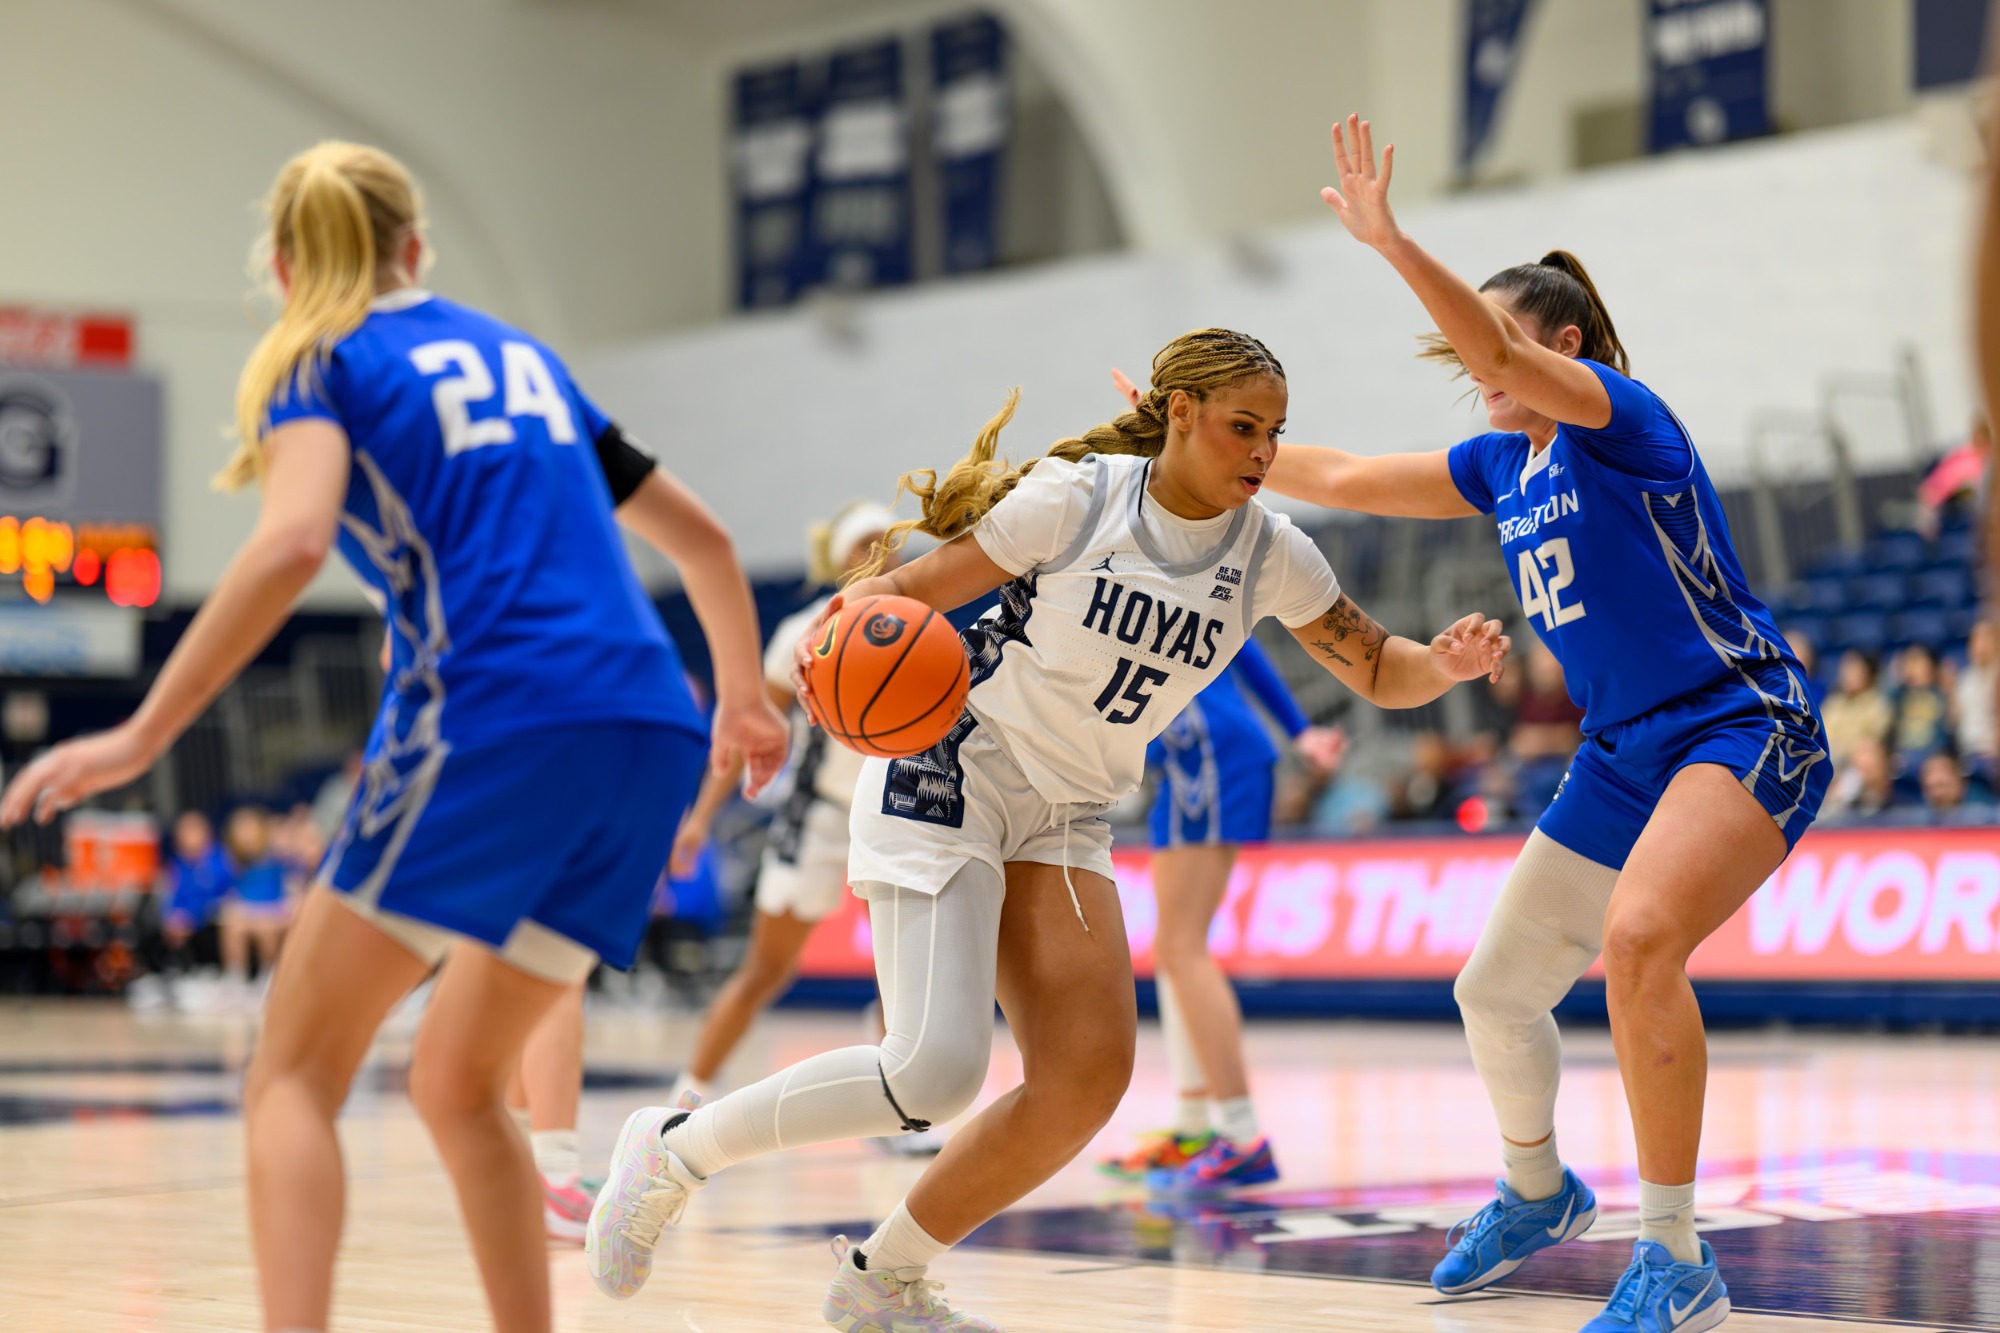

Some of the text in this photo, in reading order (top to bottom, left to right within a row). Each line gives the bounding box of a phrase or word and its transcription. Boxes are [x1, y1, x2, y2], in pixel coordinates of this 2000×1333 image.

[408, 338, 578, 459] 24
[1210, 591, 1234, 602] EAST
[1214, 585, 1232, 595] BIG
[1219, 566, 1230, 575] BE
[1517, 537, 1587, 633] 42
[1081, 576, 1225, 670] HOYAS
[1093, 656, 1171, 725] 15
[1345, 858, 1517, 957] THI
[1749, 849, 2000, 955] WOR
